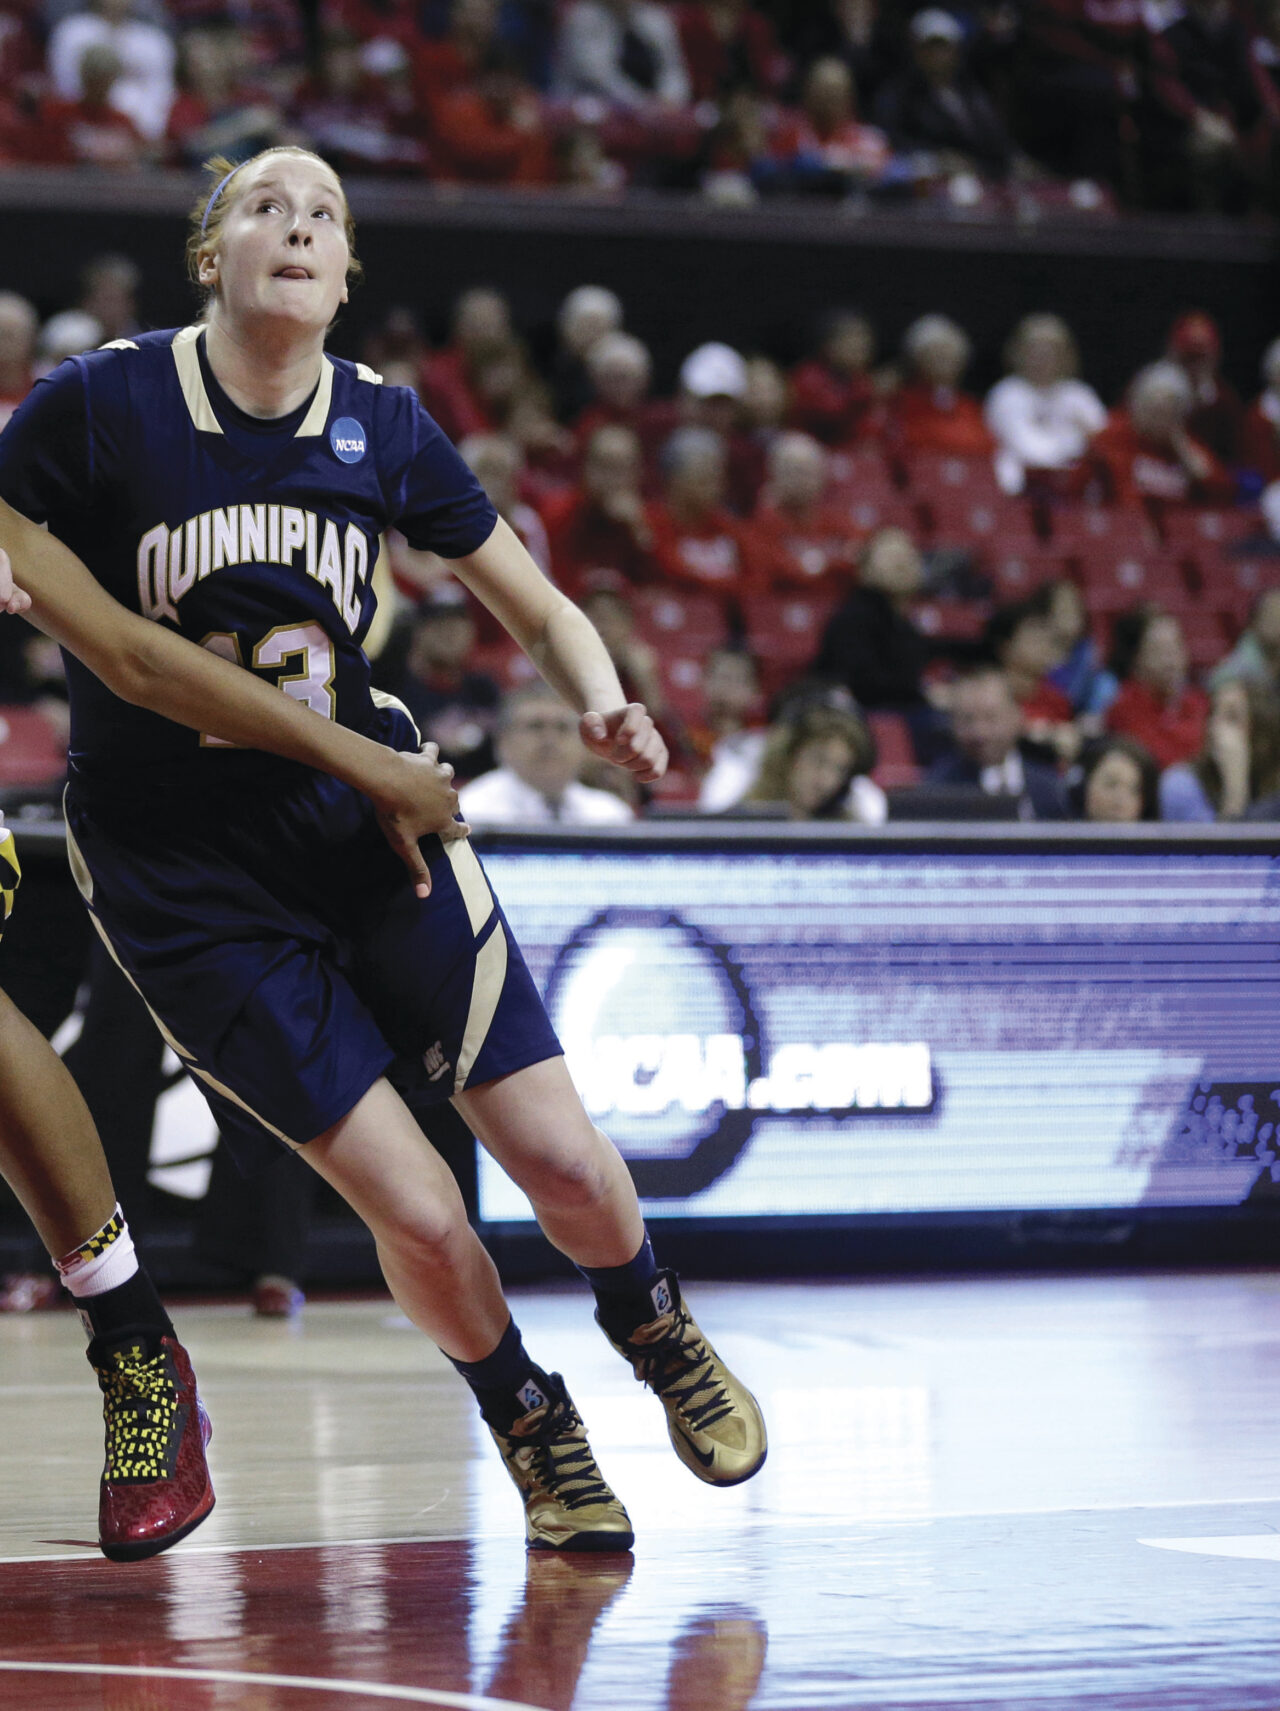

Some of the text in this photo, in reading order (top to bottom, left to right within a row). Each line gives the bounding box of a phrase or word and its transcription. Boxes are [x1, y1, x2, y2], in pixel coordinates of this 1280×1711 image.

[336, 439, 365, 453] NCAA
[137, 504, 368, 635] QUINNIPIAC
[199, 620, 336, 747] 3
